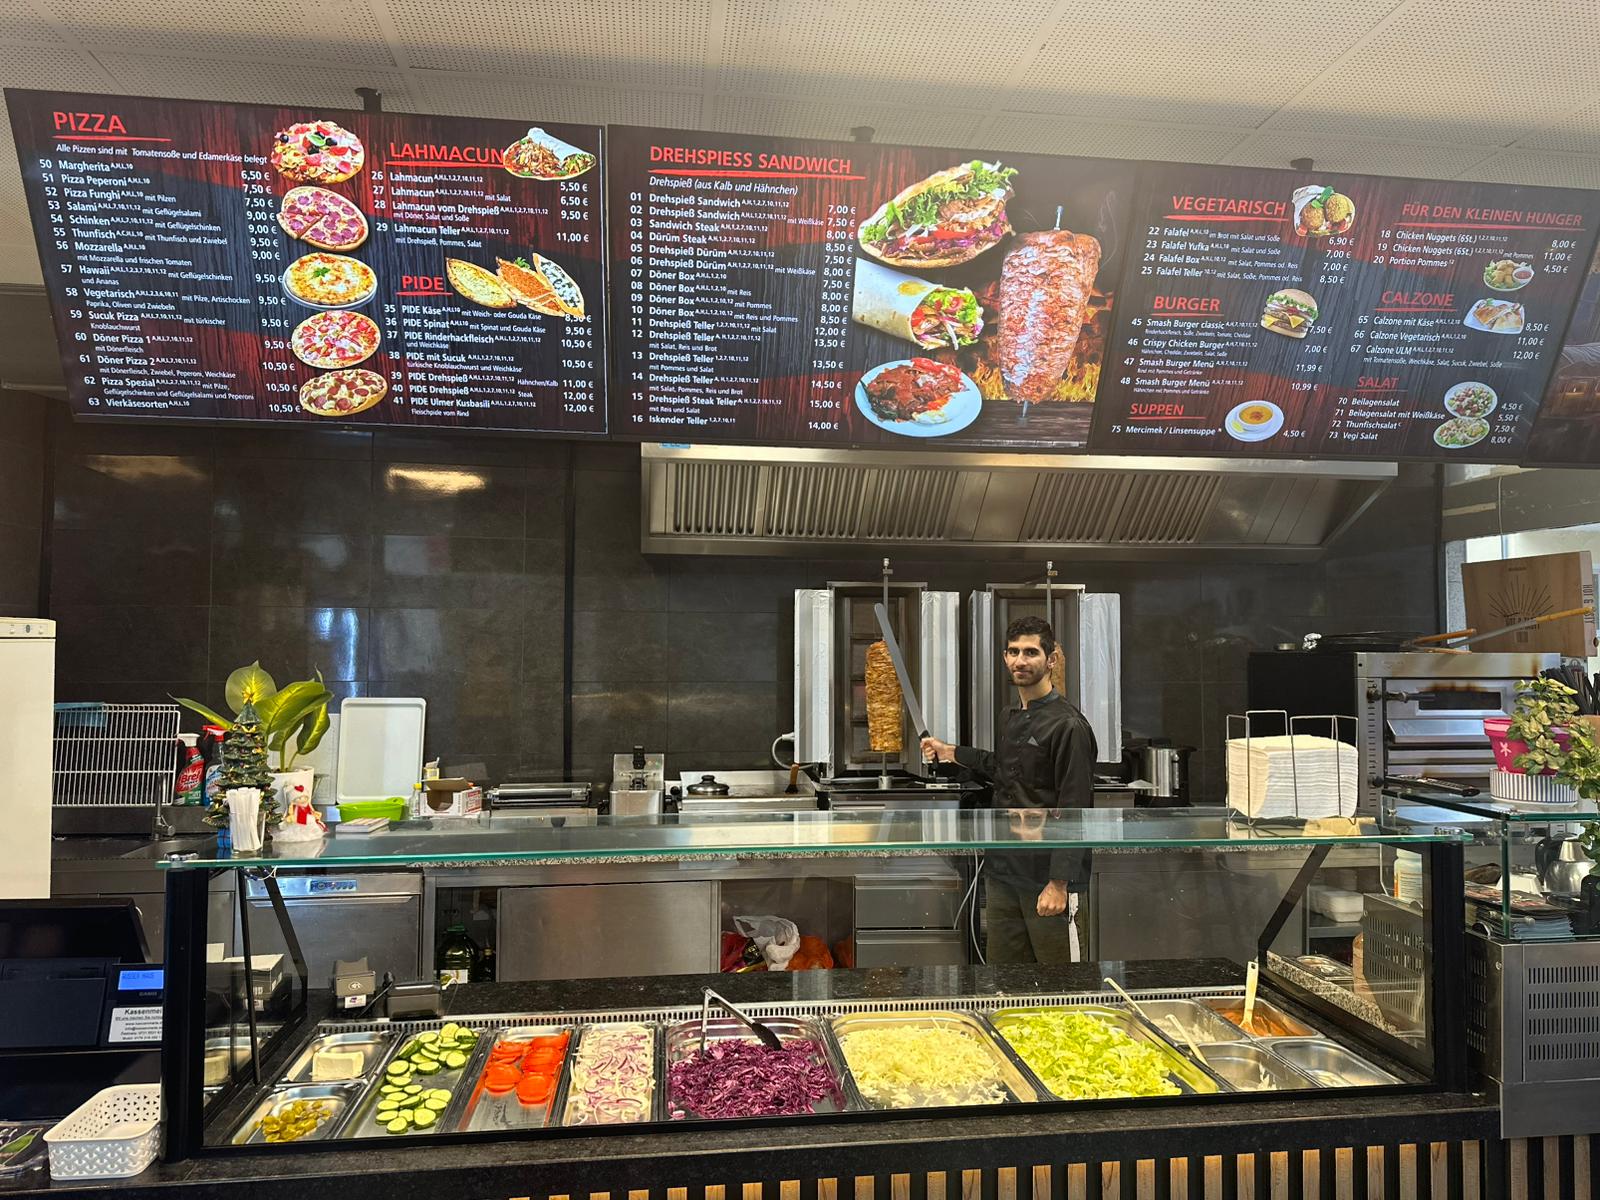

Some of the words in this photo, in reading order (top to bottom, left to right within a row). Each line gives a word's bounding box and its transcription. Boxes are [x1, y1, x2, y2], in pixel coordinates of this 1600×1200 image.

[53, 111, 127, 134] PIZZA
[56, 144, 71, 152] Alle
[72, 145, 96, 154] Pizzen
[98, 146, 113, 155] sind
[132, 148, 180, 158] Tomatensoße
[182, 152, 196, 160] und
[199, 152, 242, 162] Edamerkäse
[244, 155, 267, 164] belegt
[390, 142, 503, 164] LAHMACUN
[650, 146, 752, 169] DREHSPIESS
[758, 154, 851, 174] SANDWICH
[40, 159, 52, 168] 50
[241, 171, 263, 181] 6,50
[42, 174, 54, 182] 51
[62, 174, 85, 184] Pizza
[243, 184, 264, 194] 7,50
[372, 171, 383, 180] 26
[560, 182, 580, 192] 5,50
[649, 176, 692, 190] Drehspieß
[694, 179, 712, 190] (aus
[714, 180, 732, 191] Kalb
[734, 182, 751, 192] und
[753, 182, 798, 196] Hähnchen)
[45, 187, 57, 196] 52
[64, 188, 88, 198] Pizza
[373, 186, 384, 194] 27
[561, 196, 580, 206] 6,50
[48, 201, 60, 210] 53
[247, 211, 268, 221] 9,00
[392, 201, 435, 212] Lahmacun
[437, 204, 456, 213] vom
[561, 210, 580, 220] 9,50
[630, 193, 641, 201] 01
[649, 193, 695, 206] Drehspieß
[828, 205, 848, 214] 7,00
[1172, 196, 1286, 216] VEGETARISCH
[630, 206, 642, 214] 02
[649, 206, 695, 219] Drehspieß
[1403, 203, 1429, 218] FÜR
[1433, 207, 1462, 220] DEN
[1465, 208, 1522, 223] KLEINEN
[1526, 212, 1583, 227] HUNGER
[50, 214, 63, 223] 54
[248, 225, 270, 235] 9,00
[376, 223, 388, 231] 29
[395, 224, 437, 234] Lahmacun
[557, 232, 581, 242] 11,00
[649, 219, 693, 231] Sandwich
[826, 230, 846, 240] 8,00
[251, 238, 272, 248] 9,50
[630, 231, 642, 240] 04
[649, 232, 680, 242] Dürüm
[1329, 238, 1347, 247] 6,90
[1396, 231, 1425, 241] Chicken
[1426, 233, 1456, 243] Nuggets
[649, 245, 694, 257] Drehspieß
[825, 255, 844, 265] 7,50
[1161, 241, 1186, 250] Falafel
[1326, 250, 1345, 259] 7,00
[90, 254, 124, 264] Mozzarella
[1389, 257, 1416, 267] Portion
[1544, 265, 1561, 274] 4,50
[61, 265, 72, 273] 57
[255, 274, 276, 284] 9,50
[1156, 267, 1181, 276] Falafel
[402, 275, 444, 291] PIDE
[631, 282, 642, 290] 08
[649, 282, 676, 293] Döner
[1154, 296, 1221, 312] BURGER
[1382, 291, 1454, 307] CALZONE
[402, 305, 421, 314] PIDE
[821, 304, 841, 313] 8,00
[70, 310, 82, 318] 59
[89, 310, 115, 320] Sucuk
[117, 312, 138, 322] Pizza
[262, 318, 282, 328] 9,50
[386, 318, 397, 326] 36
[403, 319, 421, 327] PIDE
[566, 326, 585, 336] 9,50
[1146, 319, 1171, 328] Smash
[1173, 321, 1198, 331] Burger
[1373, 316, 1402, 326] Calzone
[1526, 323, 1541, 331] 8,50
[649, 319, 691, 330] Drehspieß
[815, 327, 840, 337] 12,00
[93, 333, 119, 343] Döner
[122, 334, 143, 344] Pizza
[404, 332, 422, 341] PIDE
[561, 339, 585, 349] 10,50
[1143, 339, 1166, 350] Crispy
[1168, 339, 1197, 348] Chicken
[1370, 331, 1398, 341] Calzone
[1517, 337, 1538, 346] 11,00
[79, 355, 90, 363] 61
[98, 354, 124, 365] Döner
[126, 356, 148, 366] Pizza
[263, 362, 288, 372] 10,50
[406, 352, 424, 361] PIDE
[426, 353, 440, 361] mit
[649, 352, 691, 364] Drehspieß
[813, 360, 838, 369] 13,50
[1296, 364, 1317, 373] 11,99
[84, 377, 96, 385] 62
[102, 377, 123, 387] Pizza
[266, 383, 292, 393] 10,50
[563, 380, 586, 389] 11,00
[1292, 383, 1312, 392] 10,99
[1357, 376, 1399, 389] SALAT
[269, 404, 294, 414] 10,50
[410, 398, 428, 406] PIDE
[430, 398, 454, 408] Ulmer
[564, 404, 587, 413] 12,00
[649, 394, 690, 405] Drehspieß
[692, 396, 714, 406] Steak
[810, 400, 835, 410] 15,00
[1352, 398, 1400, 408] Beilagensalat
[1130, 404, 1185, 417] SUPPEN
[649, 416, 684, 425] Iskender
[808, 422, 832, 431] 14,00
[1126, 426, 1162, 435] Mercimek
[1169, 428, 1216, 437] Linsensuppe
[1283, 430, 1300, 439] 4,50
[1343, 432, 1358, 442] Vegi
[1360, 433, 1378, 441] Salat
